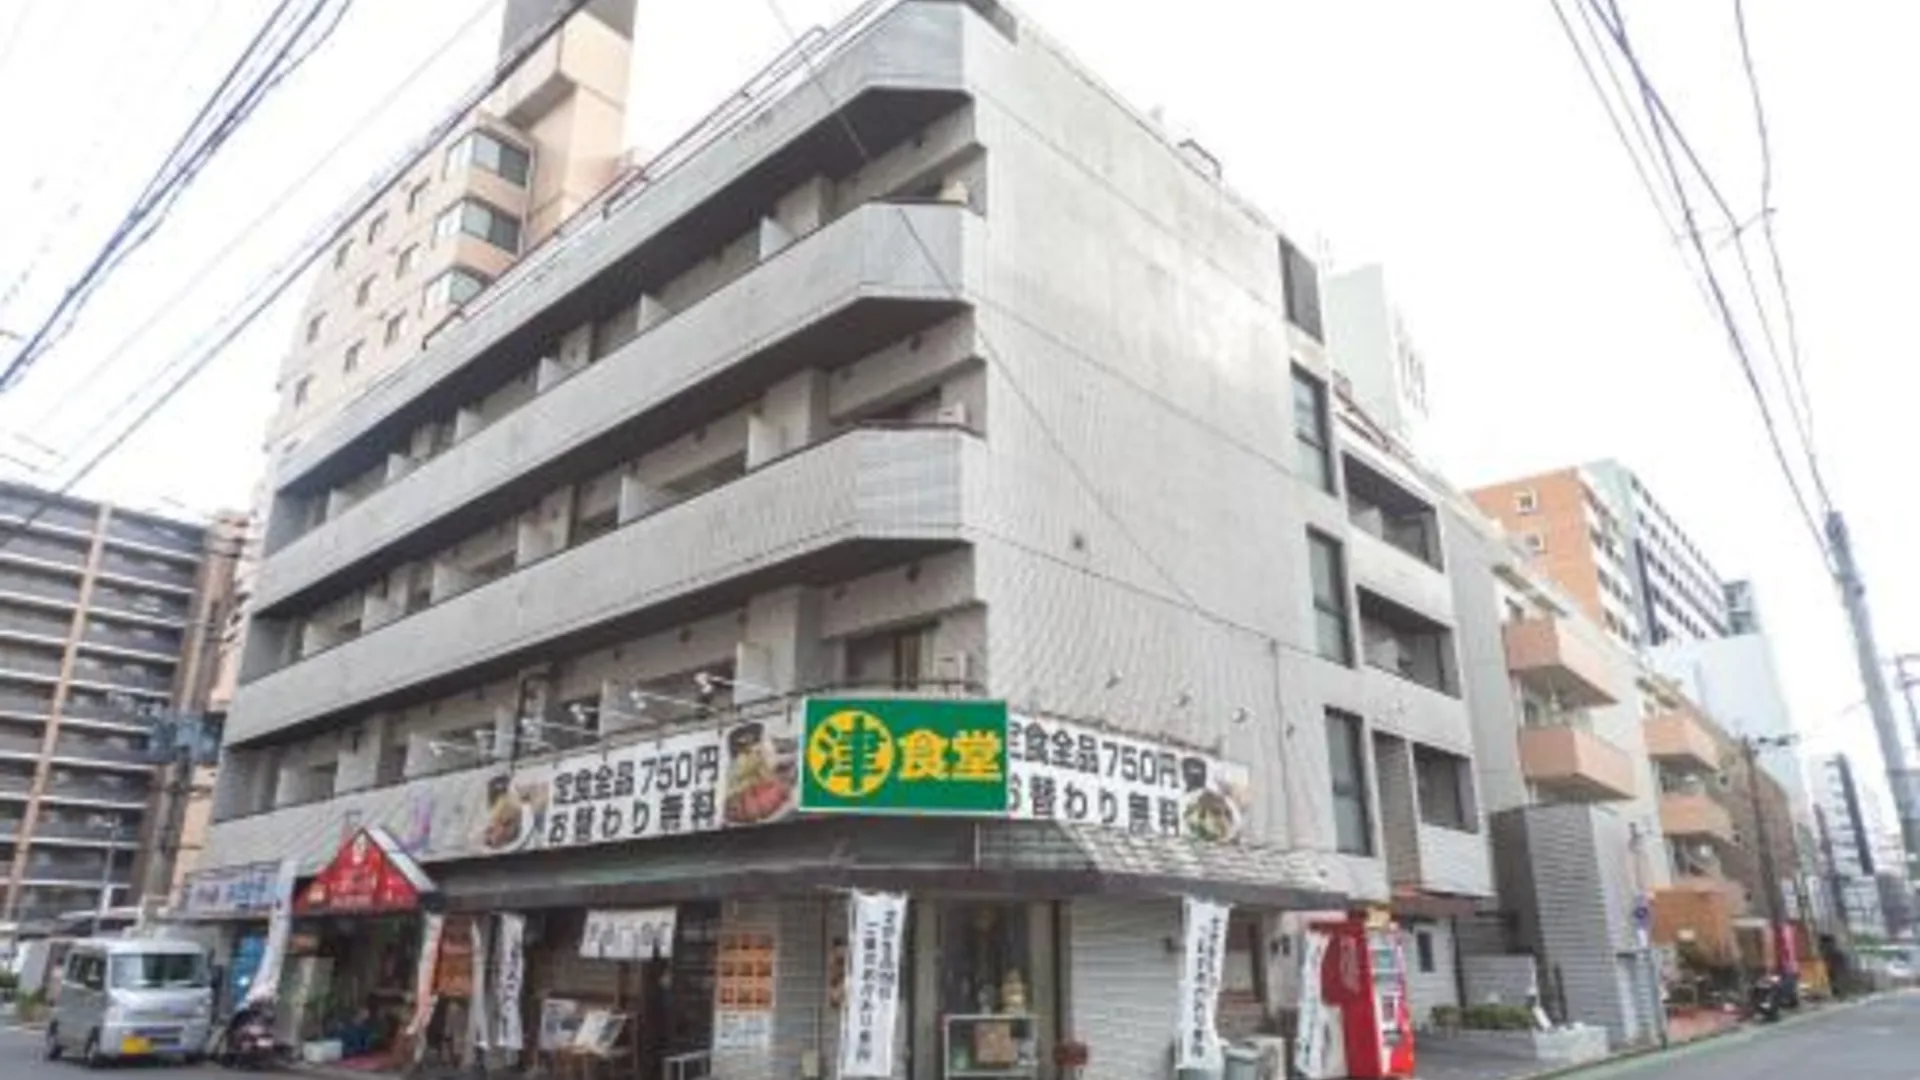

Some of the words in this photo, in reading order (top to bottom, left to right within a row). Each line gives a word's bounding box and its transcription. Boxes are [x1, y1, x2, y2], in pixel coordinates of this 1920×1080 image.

[550, 789, 716, 842] お替わり無料
